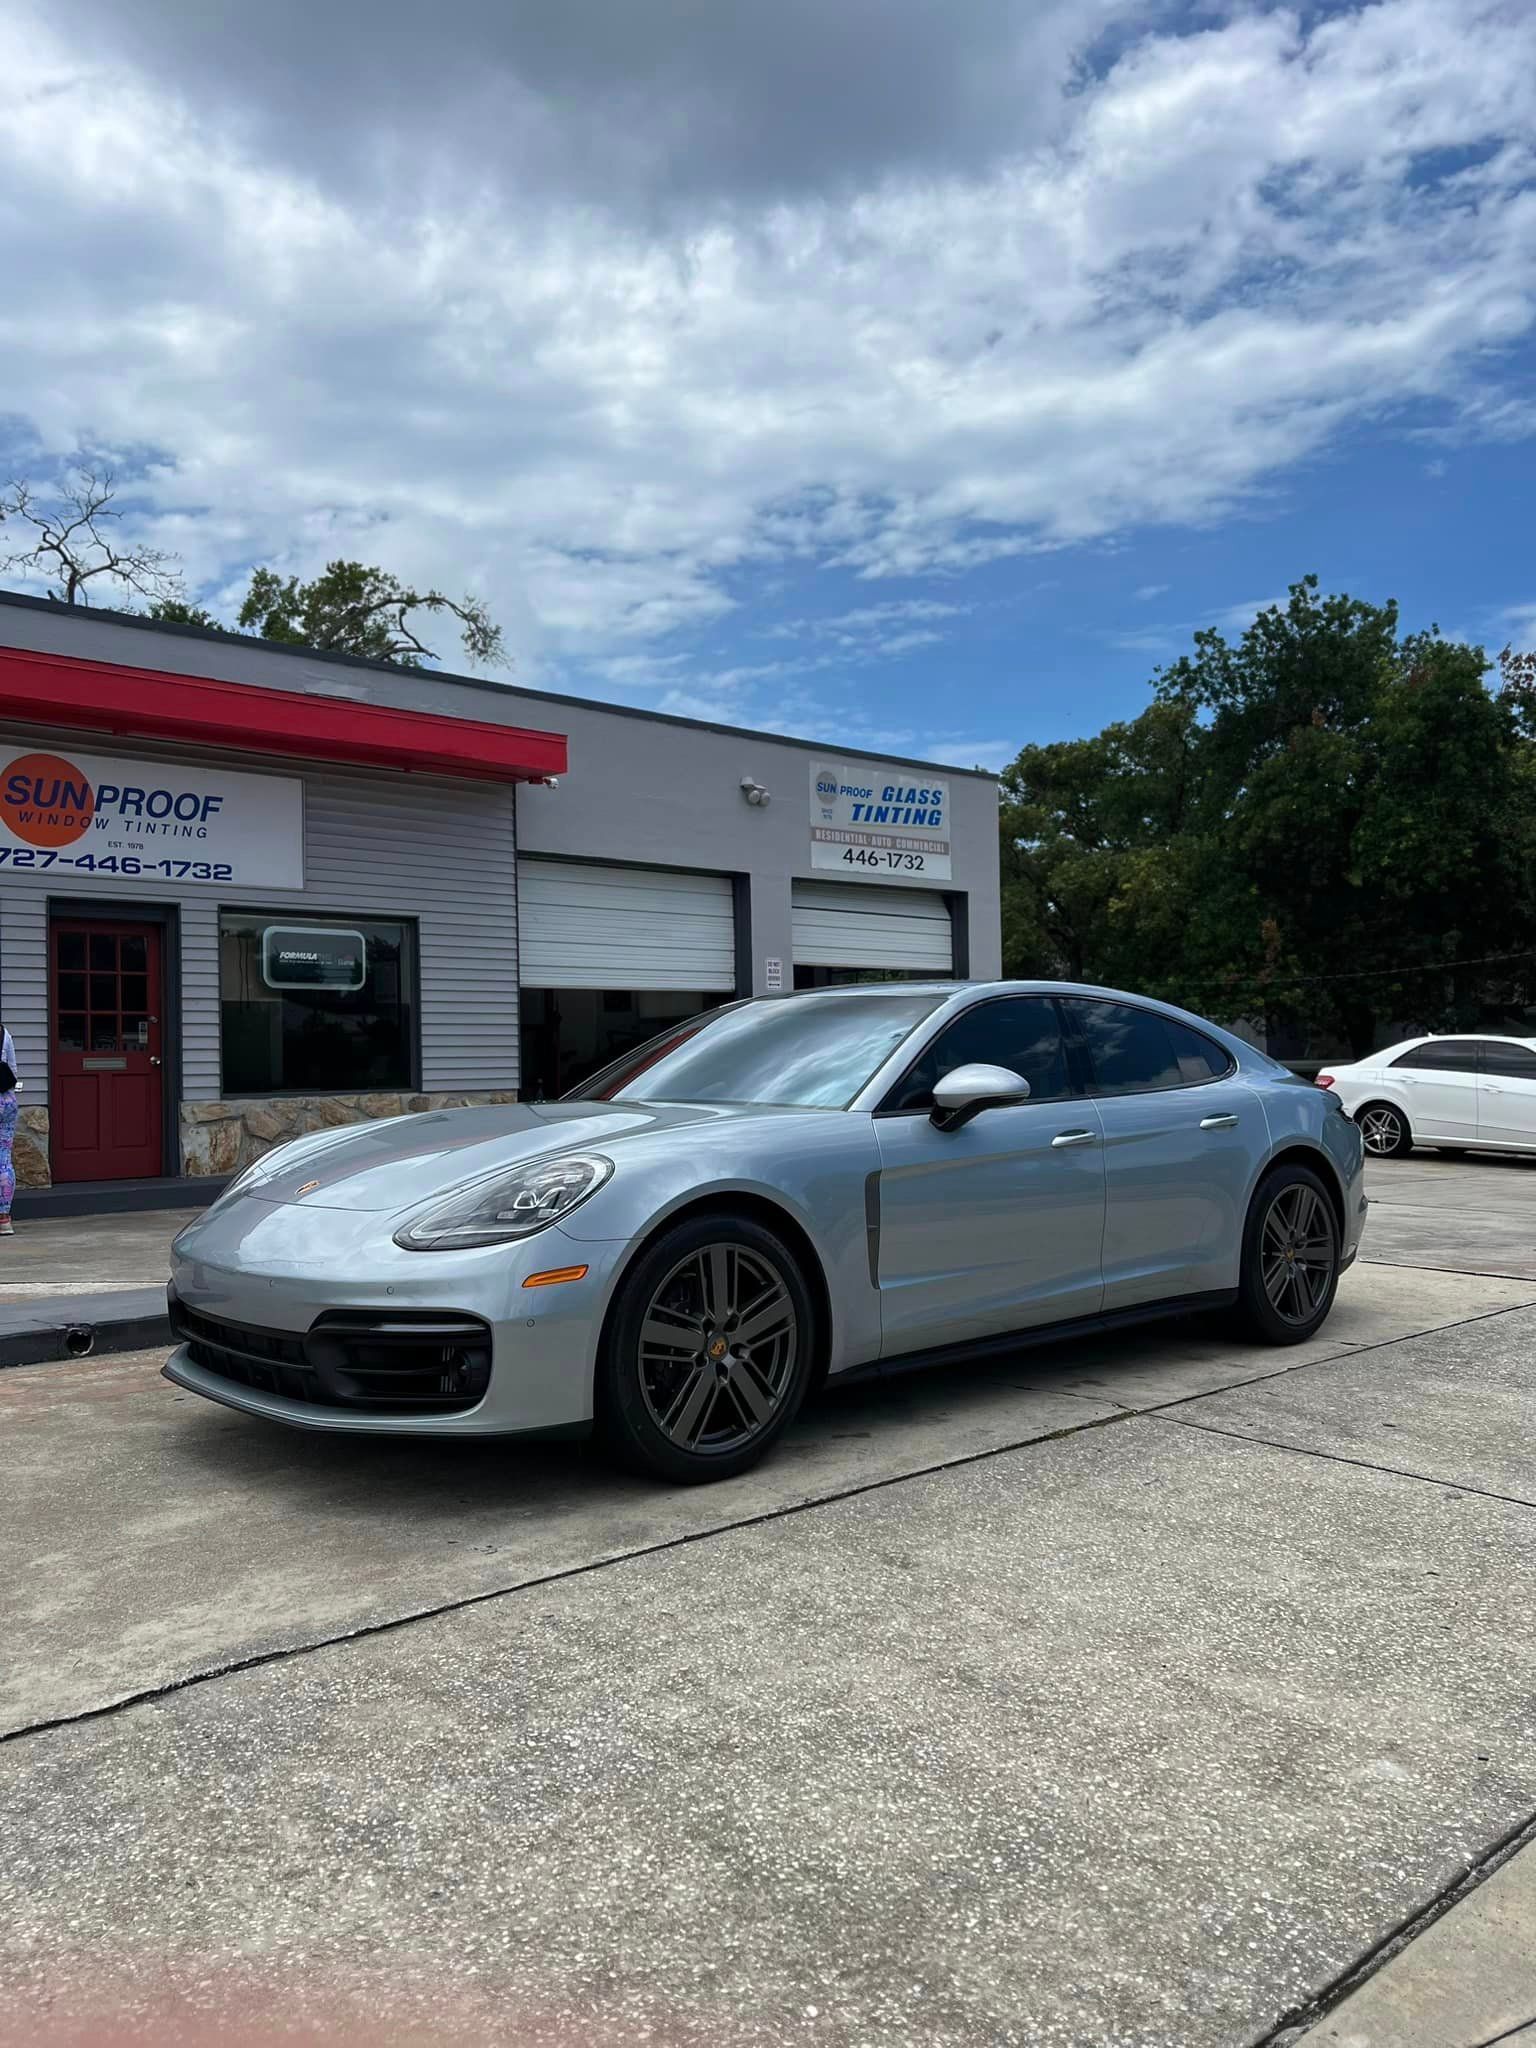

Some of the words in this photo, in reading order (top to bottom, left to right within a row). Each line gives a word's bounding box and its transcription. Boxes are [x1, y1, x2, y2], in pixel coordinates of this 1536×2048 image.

[4, 775, 90, 811] SUN
[94, 784, 224, 822] PROOF
[816, 782, 837, 794] SUN
[840, 785, 873, 799] PROOF
[881, 786, 943, 806] GLASS
[18, 811, 110, 830] WINDOW
[124, 820, 208, 839] TINTING
[852, 803, 943, 827] TINTING
[843, 848, 925, 871] 446-1732
[279, 952, 318, 961] FORMULA
